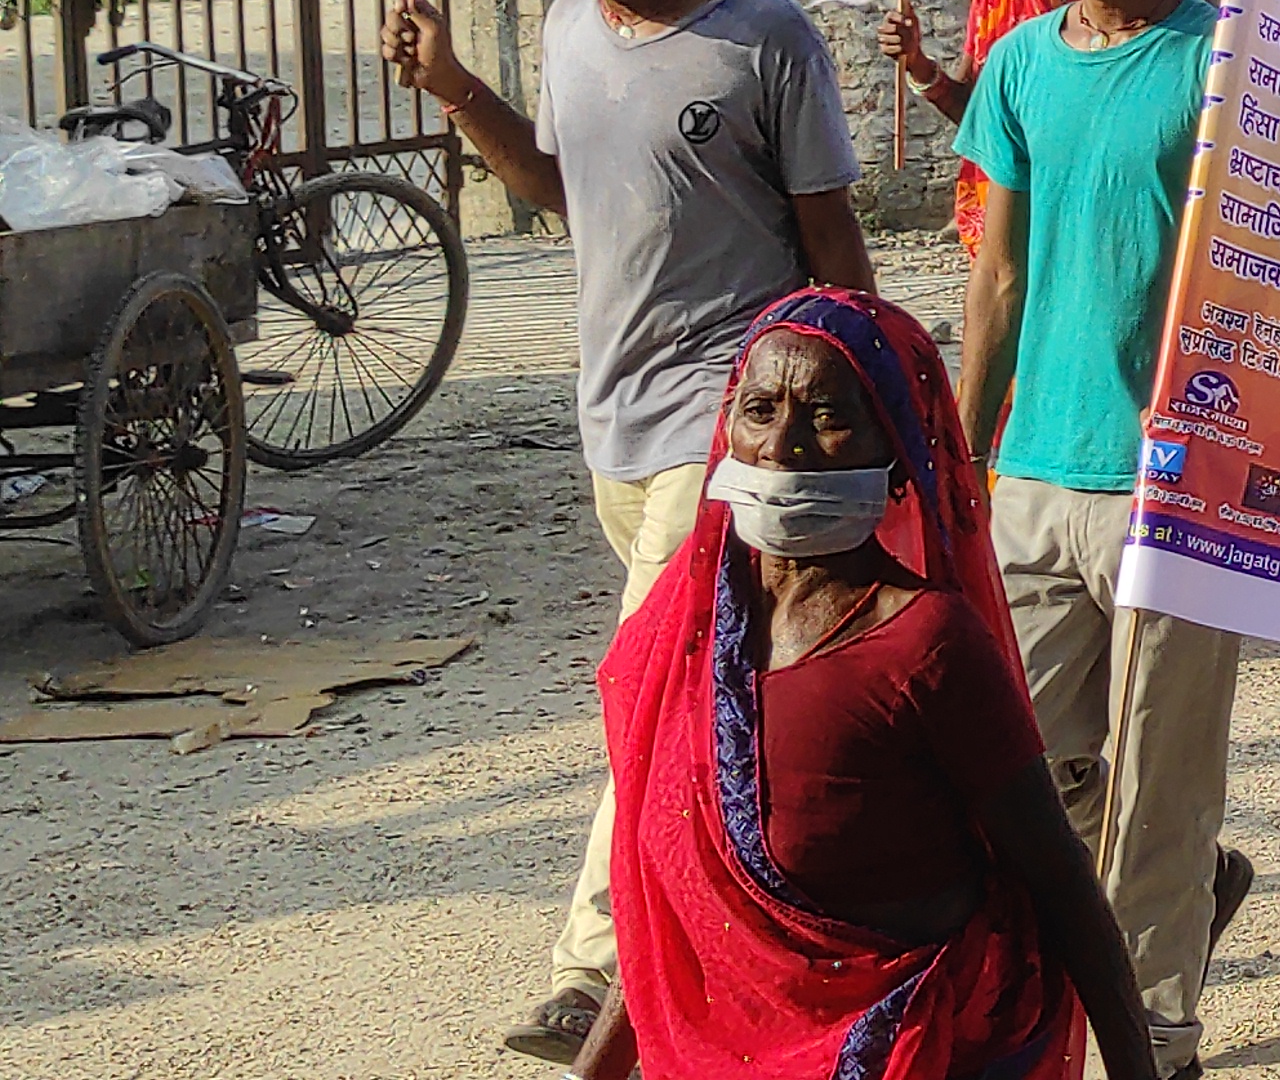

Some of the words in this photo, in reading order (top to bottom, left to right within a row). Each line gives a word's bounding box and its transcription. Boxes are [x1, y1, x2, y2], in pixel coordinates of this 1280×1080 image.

[1239, 93, 1280, 142] हिंसा
[1202, 301, 1249, 333] अवश्य
[1154, 525, 1173, 544] at
